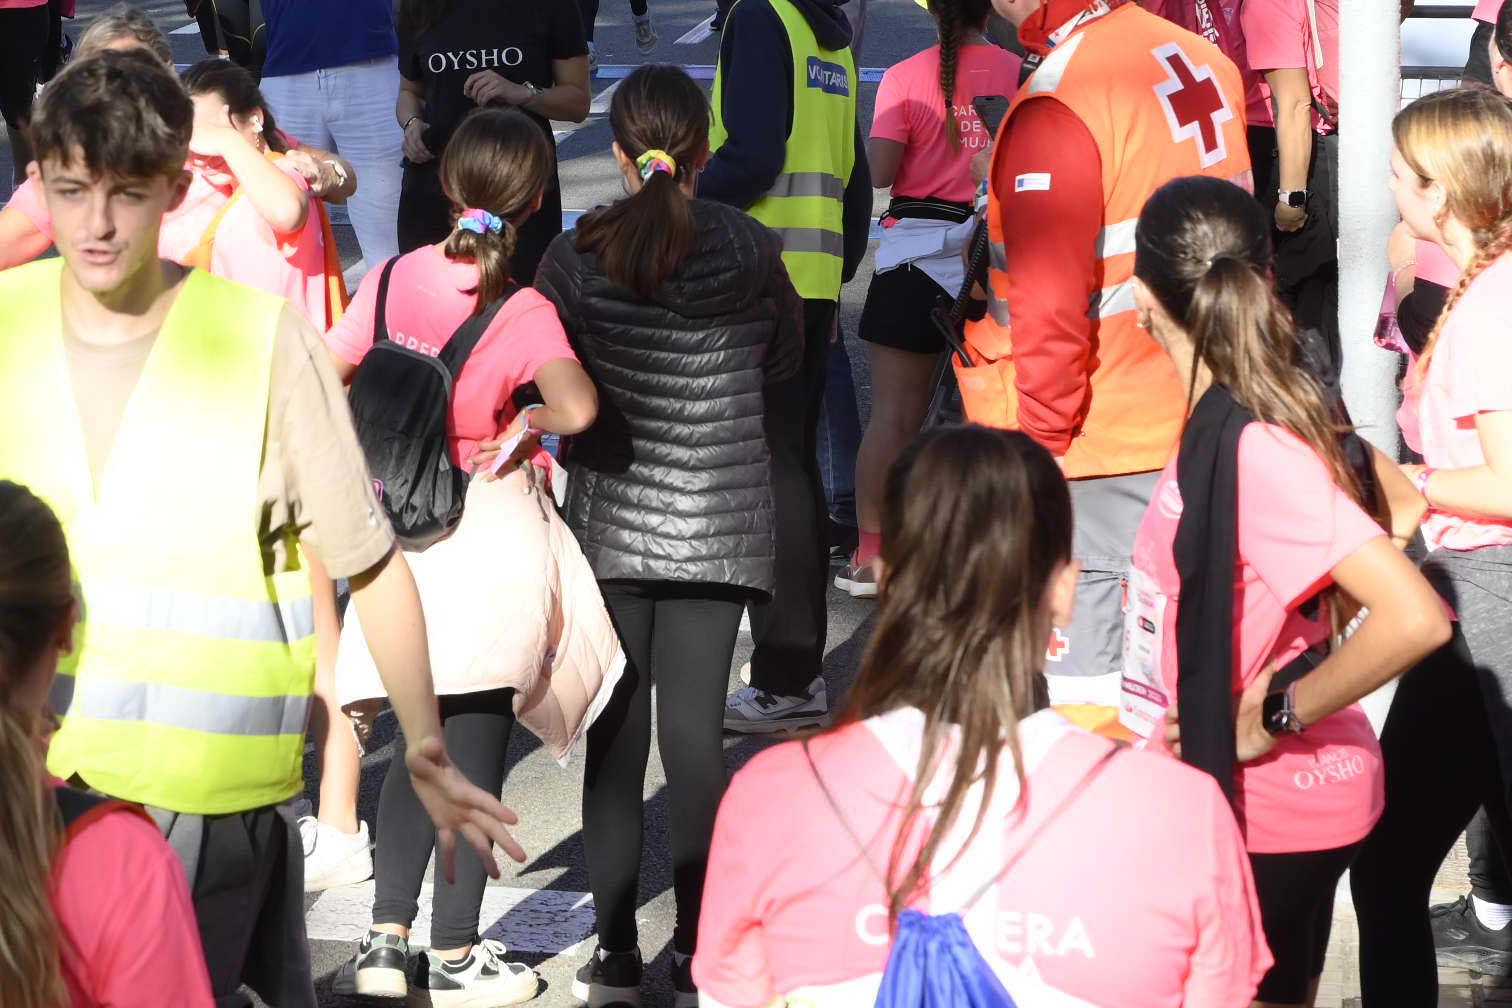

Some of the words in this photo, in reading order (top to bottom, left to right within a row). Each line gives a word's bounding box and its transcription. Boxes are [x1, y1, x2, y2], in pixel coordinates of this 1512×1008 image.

[427, 46, 524, 74] OYSHO
[960, 120, 981, 132] DE
[1294, 754, 1365, 790] OYSHO
